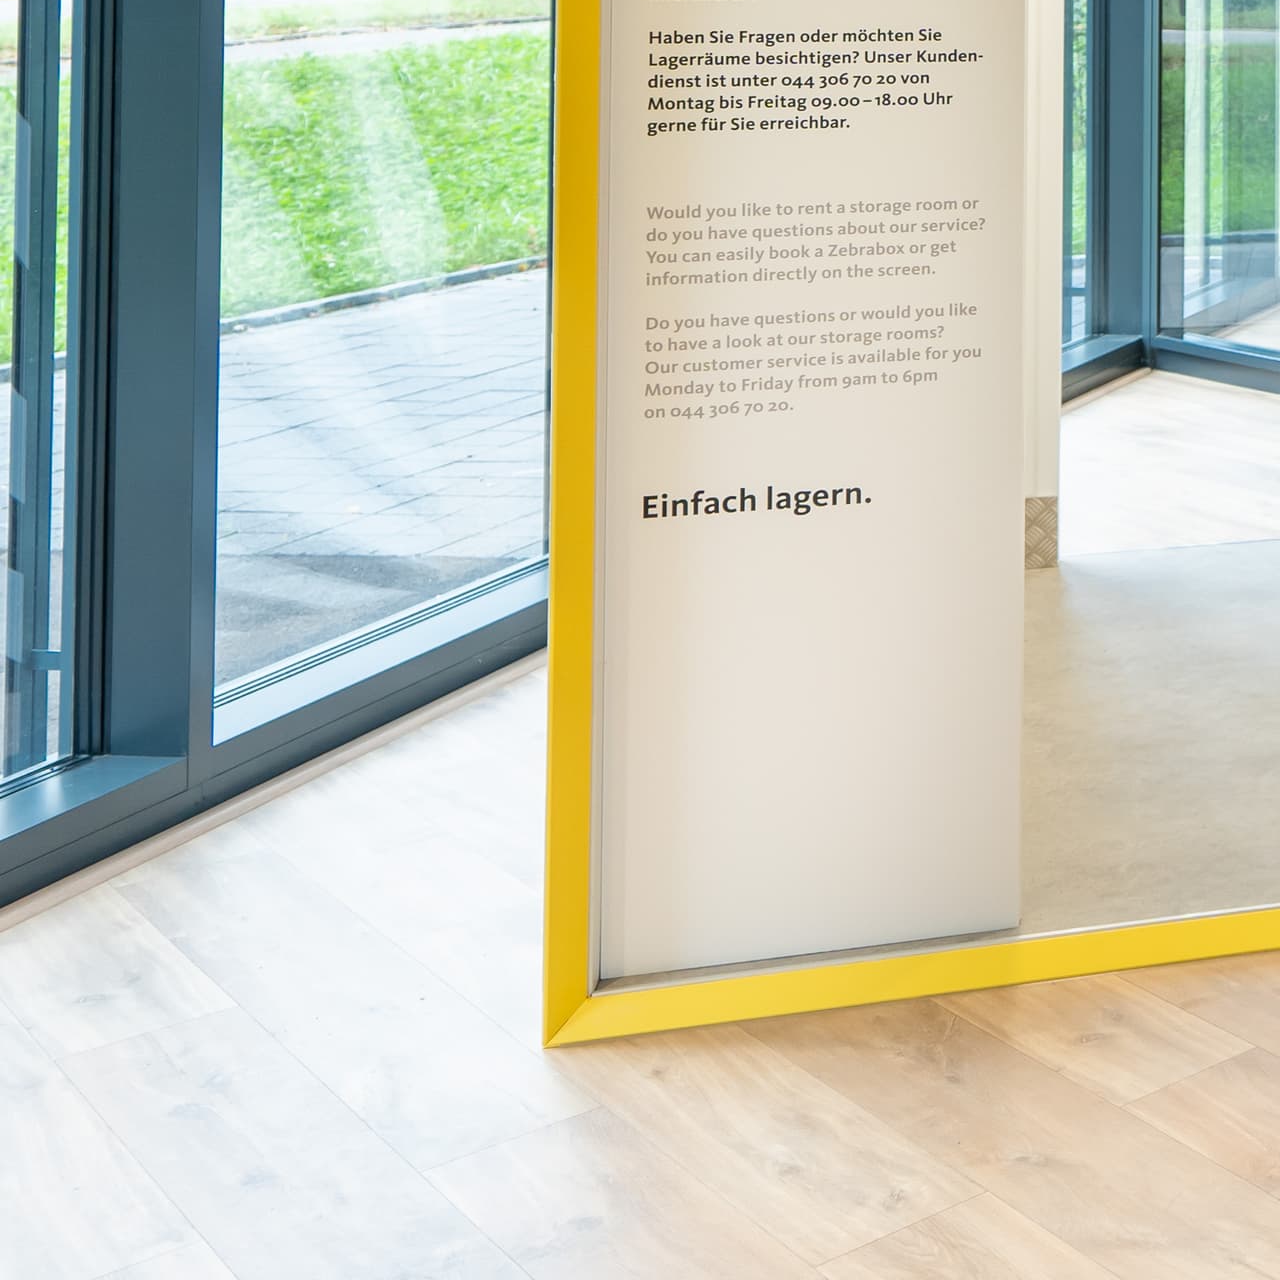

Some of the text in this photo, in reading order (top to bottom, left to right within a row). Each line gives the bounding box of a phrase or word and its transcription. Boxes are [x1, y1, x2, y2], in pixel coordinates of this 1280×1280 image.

[649, 28, 942, 48] Haben Sie Fragen oder möchten Sie
[648, 48, 984, 71] Lagerräume besichtigen? Unser Kunden-
[648, 72, 930, 89] dienst ist unter 044 306 70 20 von
[647, 96, 716, 114] Montag
[719, 95, 744, 110] bis
[748, 94, 808, 112] Freitag
[923, 91, 953, 106] Uhr
[647, 114, 850, 137] gerne für Sie erreichbar.
[646, 200, 980, 222] Would you like to rent a storage room or
[645, 239, 957, 264] You can easily book a Zebrabox or get
[646, 263, 936, 286] information directly on the screen.
[644, 346, 982, 375] Our customer service is available for you
[644, 369, 938, 398] Monday to Friday from 9am to 6pm
[644, 400, 794, 420] on 044 306 70 20.
[642, 486, 872, 519] Einfach lagern.
